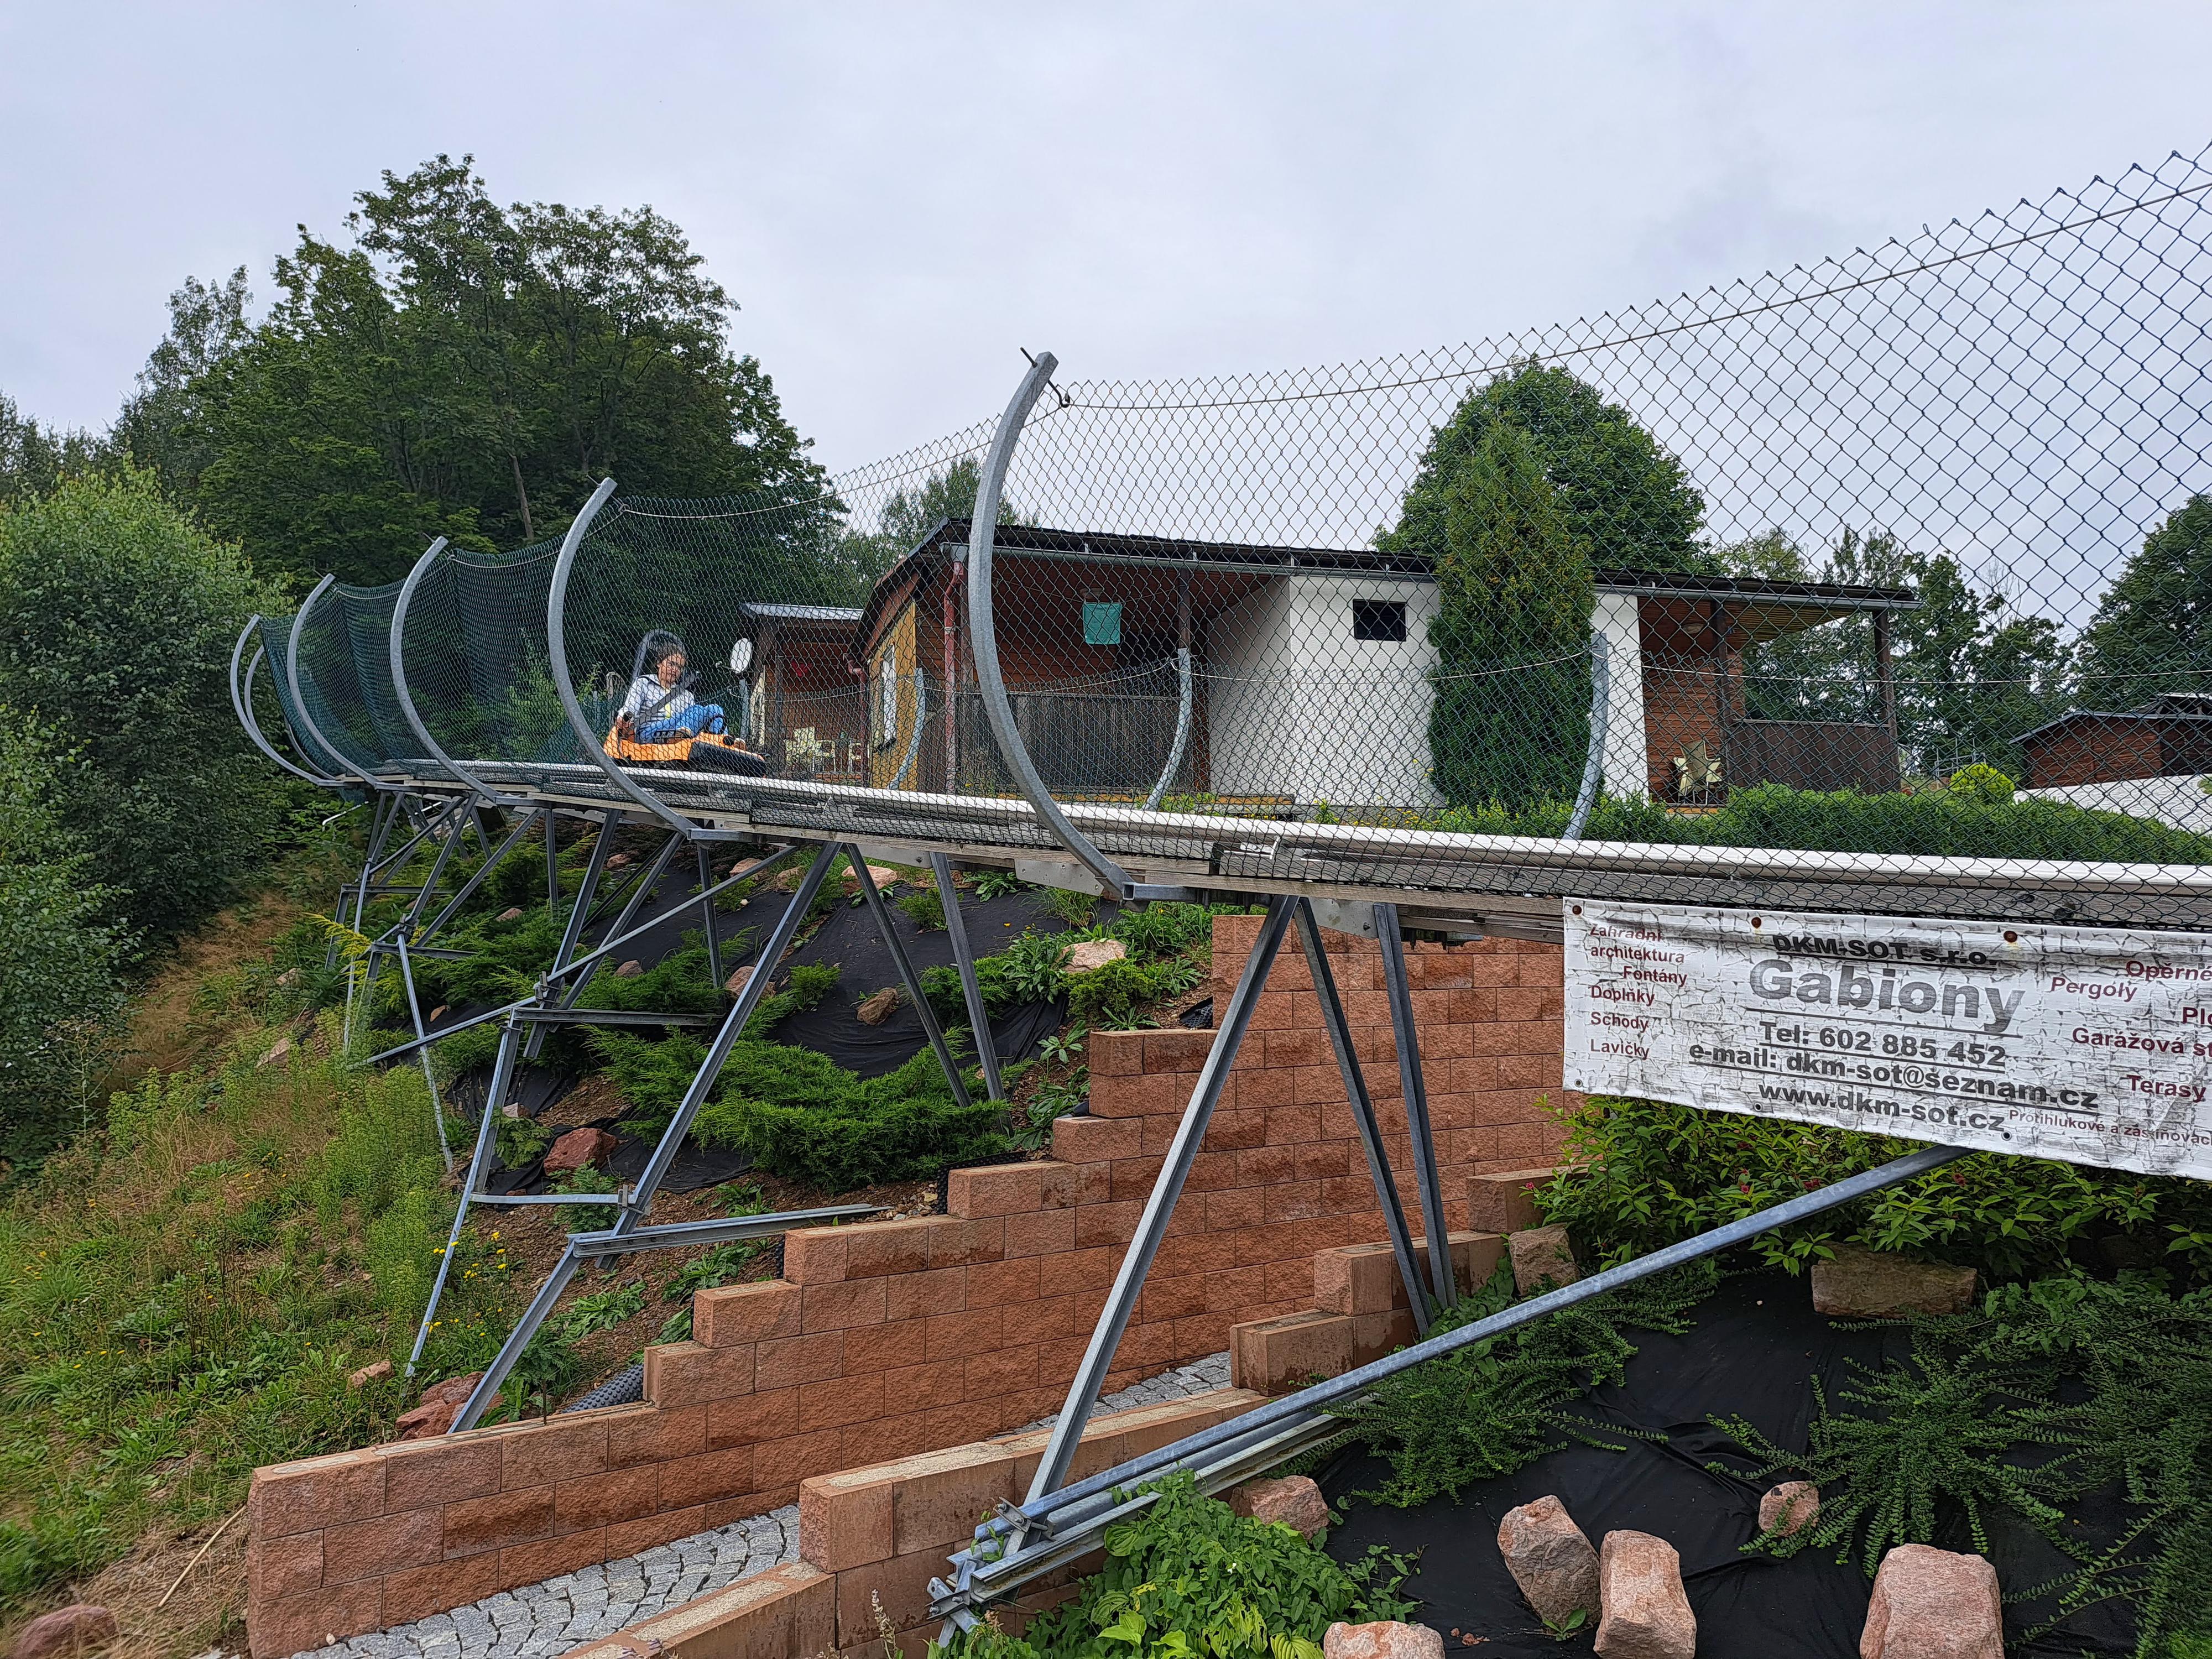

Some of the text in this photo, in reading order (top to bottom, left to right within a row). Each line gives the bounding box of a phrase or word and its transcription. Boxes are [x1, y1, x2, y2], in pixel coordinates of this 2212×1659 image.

[1591, 945, 1685, 963] architektura
[1773, 935, 1908, 958] DKM-SOT
[1624, 966, 1688, 988] Fontány
[1591, 985, 1655, 1006] Doplňky
[1749, 959, 2026, 1032] Gabiony
[1590, 1011, 1649, 1033] Schody
[1590, 1039, 1650, 1060] Lavičky
[1760, 1023, 2006, 1067] Tel: 602 885 452
[2073, 1027, 2184, 1054] Garážová
[1688, 1044, 2099, 1108] e-mail: dkm-sot@seznam.cz
[2126, 1074, 2206, 1103] Terasy
[1758, 1084, 2005, 1132] www.dkm-sot.cz
[2008, 1110, 2105, 1132] Protihlukové
